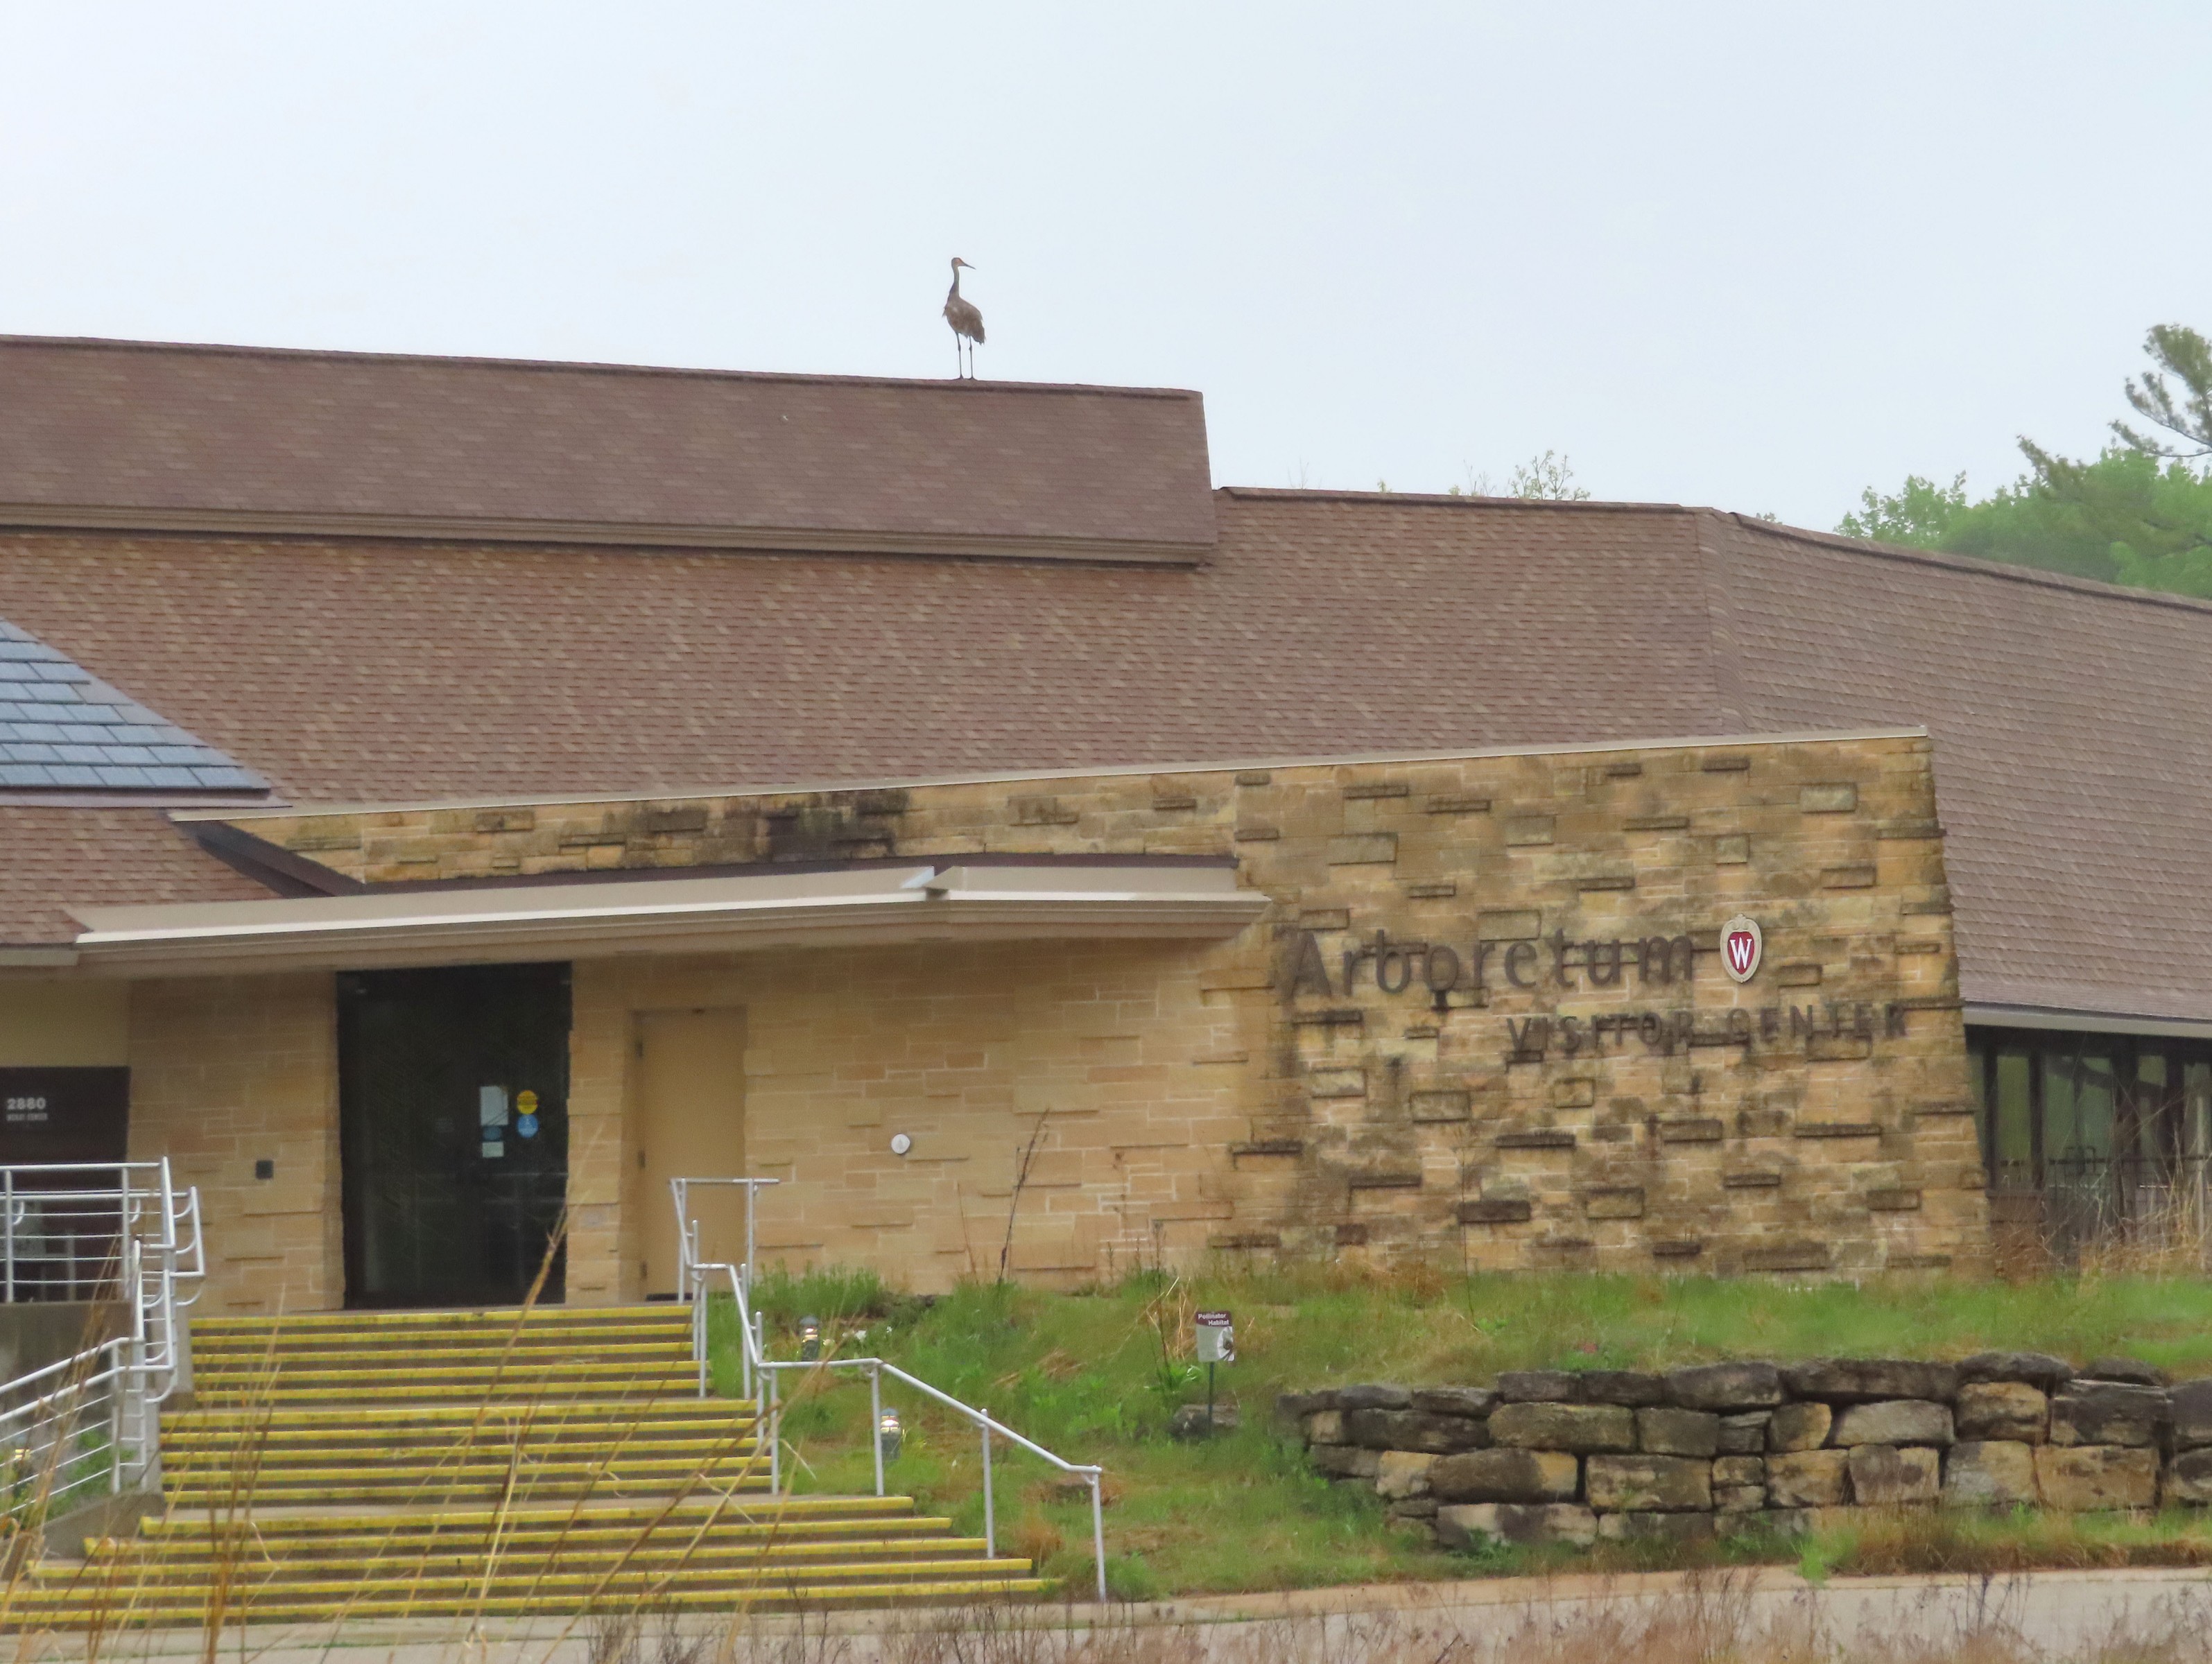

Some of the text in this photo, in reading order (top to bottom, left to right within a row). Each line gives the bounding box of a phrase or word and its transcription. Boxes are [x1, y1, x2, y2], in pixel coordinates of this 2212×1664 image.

[1286, 926, 1693, 998] Arboretum
[1729, 937, 1752, 969] W
[1506, 1004, 1908, 1051] VISITOR CENTER
